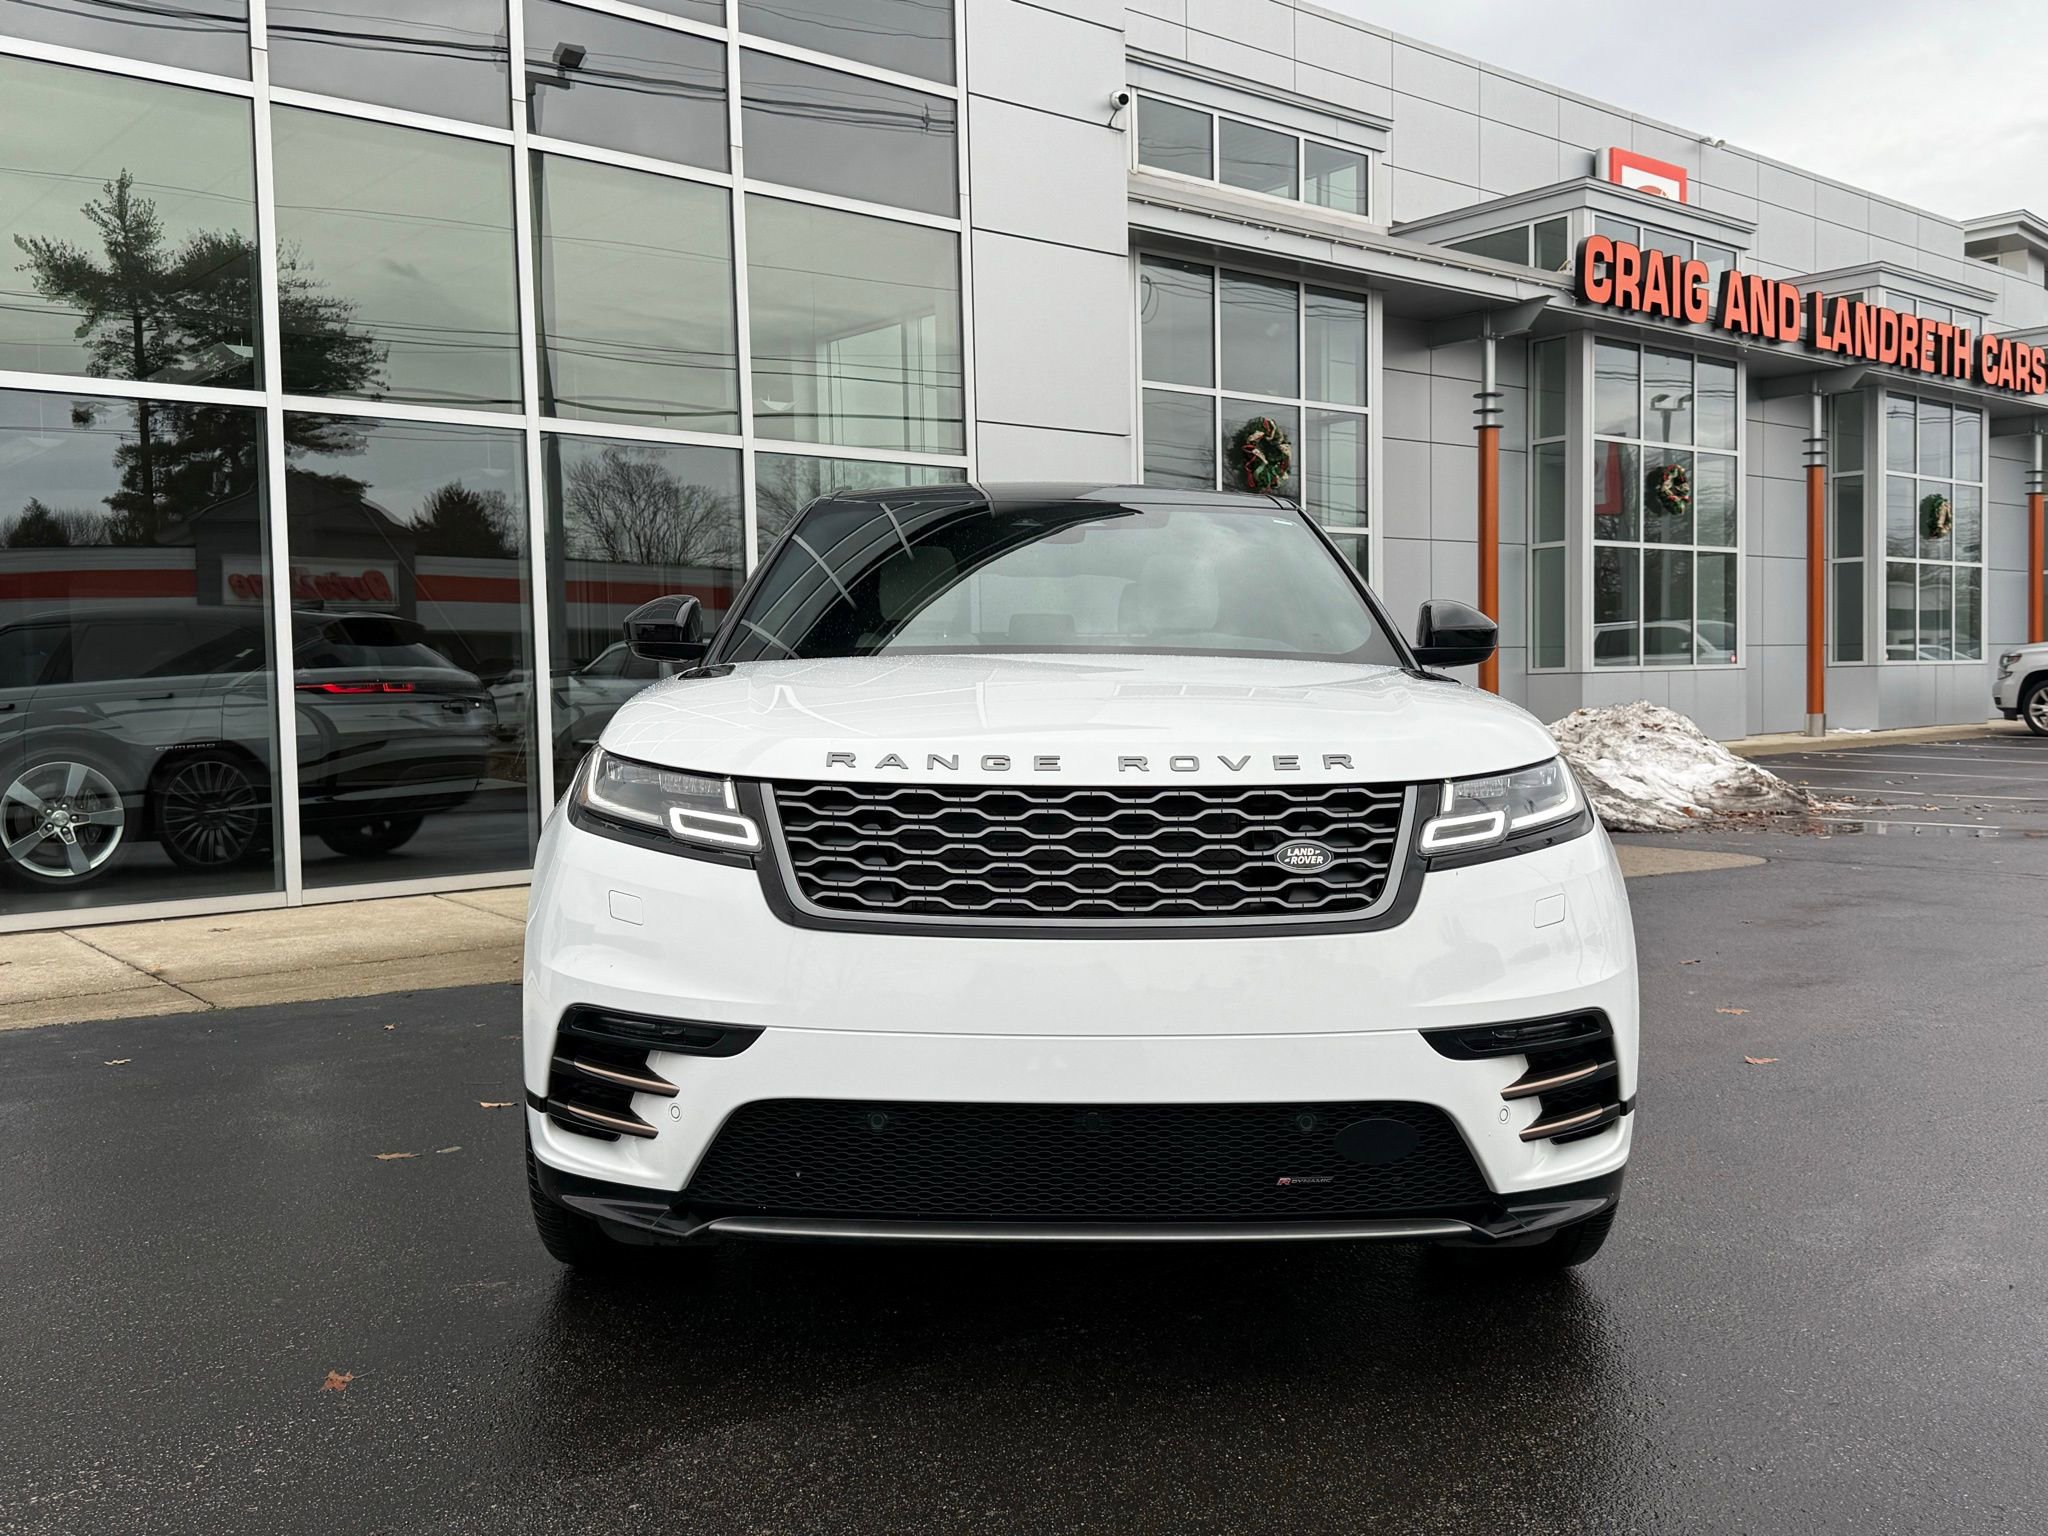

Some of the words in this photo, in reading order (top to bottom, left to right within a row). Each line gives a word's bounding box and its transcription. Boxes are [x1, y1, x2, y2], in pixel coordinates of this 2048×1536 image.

[1584, 234, 1709, 324] CRAIG
[1723, 270, 1800, 343] AND
[1812, 291, 1972, 380] LANDRETH
[1981, 333, 2047, 396] CARS
[825, 751, 1062, 772] RANGE
[1117, 753, 1355, 772] ROVER
[1287, 847, 1315, 857] LAND
[1290, 855, 1324, 865] ROVER
